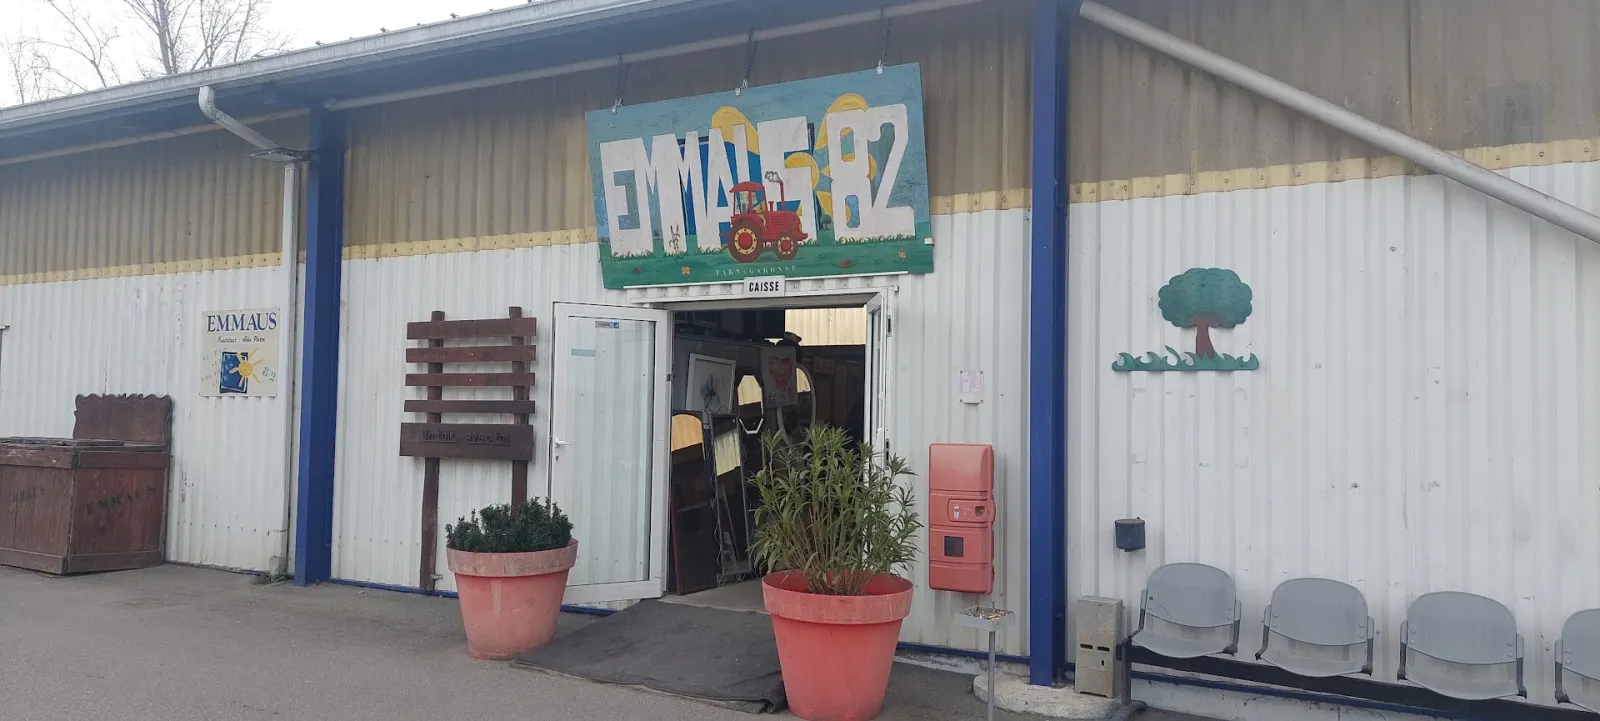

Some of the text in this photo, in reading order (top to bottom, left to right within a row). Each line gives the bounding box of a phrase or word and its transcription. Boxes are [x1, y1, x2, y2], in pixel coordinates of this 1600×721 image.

[599, 103, 917, 256] EMMAUS 82
[715, 268, 740, 276] TARN
[749, 265, 797, 274] GARONNE
[748, 281, 779, 292] CAISSE
[207, 312, 277, 332] EMMAUS
